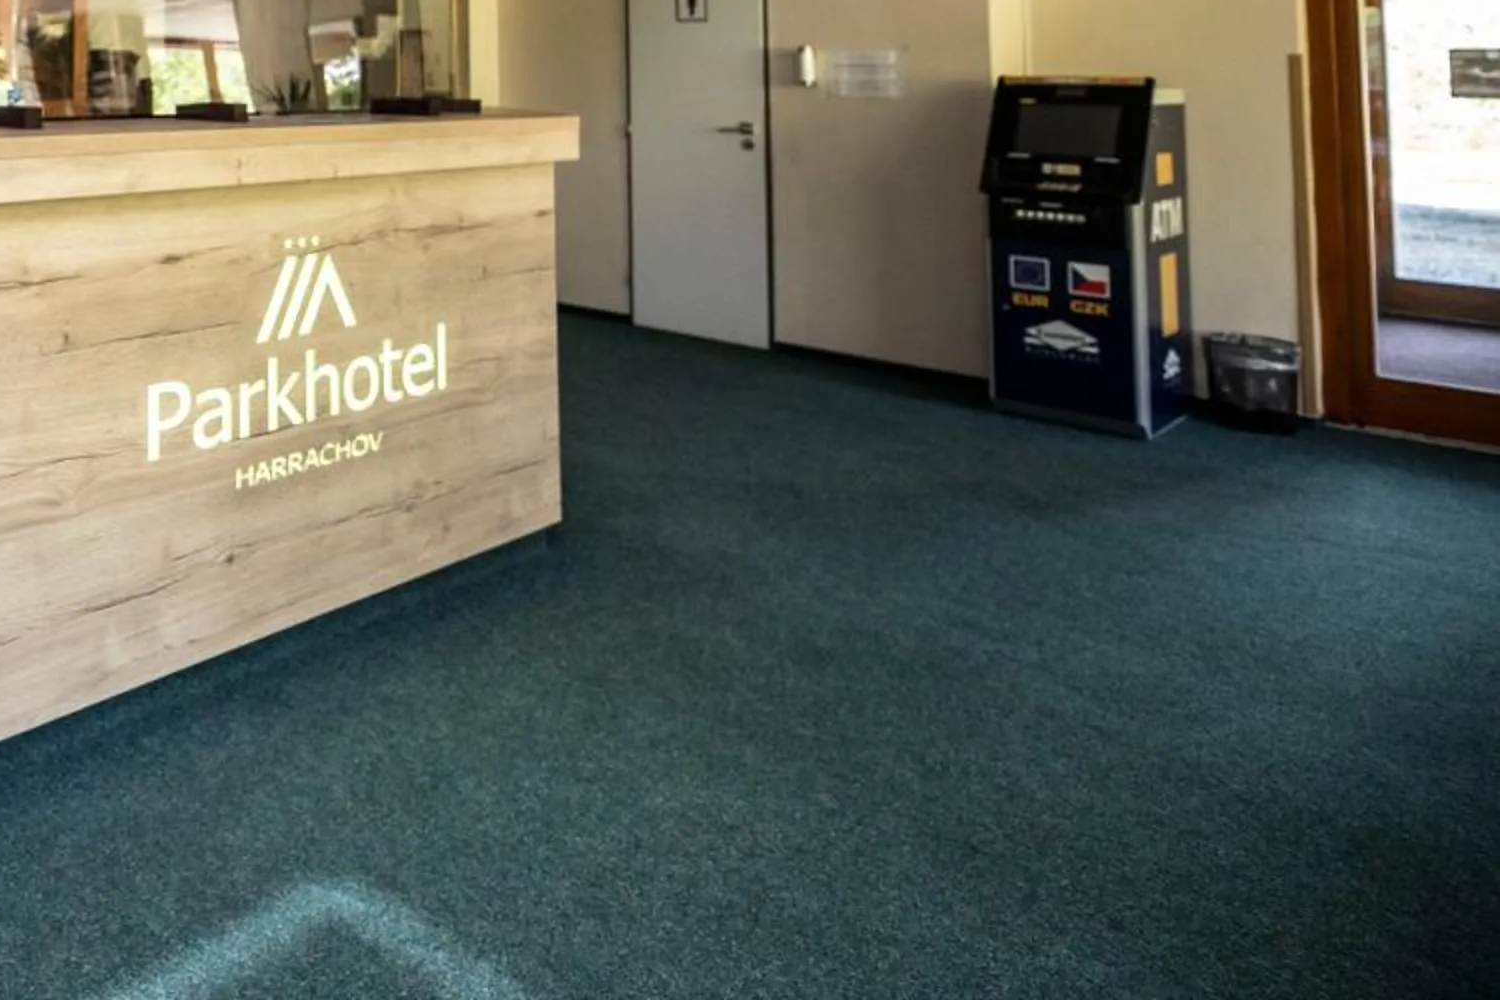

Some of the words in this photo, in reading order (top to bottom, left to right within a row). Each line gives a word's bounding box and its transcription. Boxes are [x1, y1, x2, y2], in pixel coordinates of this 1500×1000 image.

[1151, 197, 1184, 242] ATM
[1012, 292, 1049, 308] EUR
[1070, 299, 1109, 316] CZK
[147, 322, 448, 462] Parkhotel
[235, 430, 385, 490] HARRACHOV
